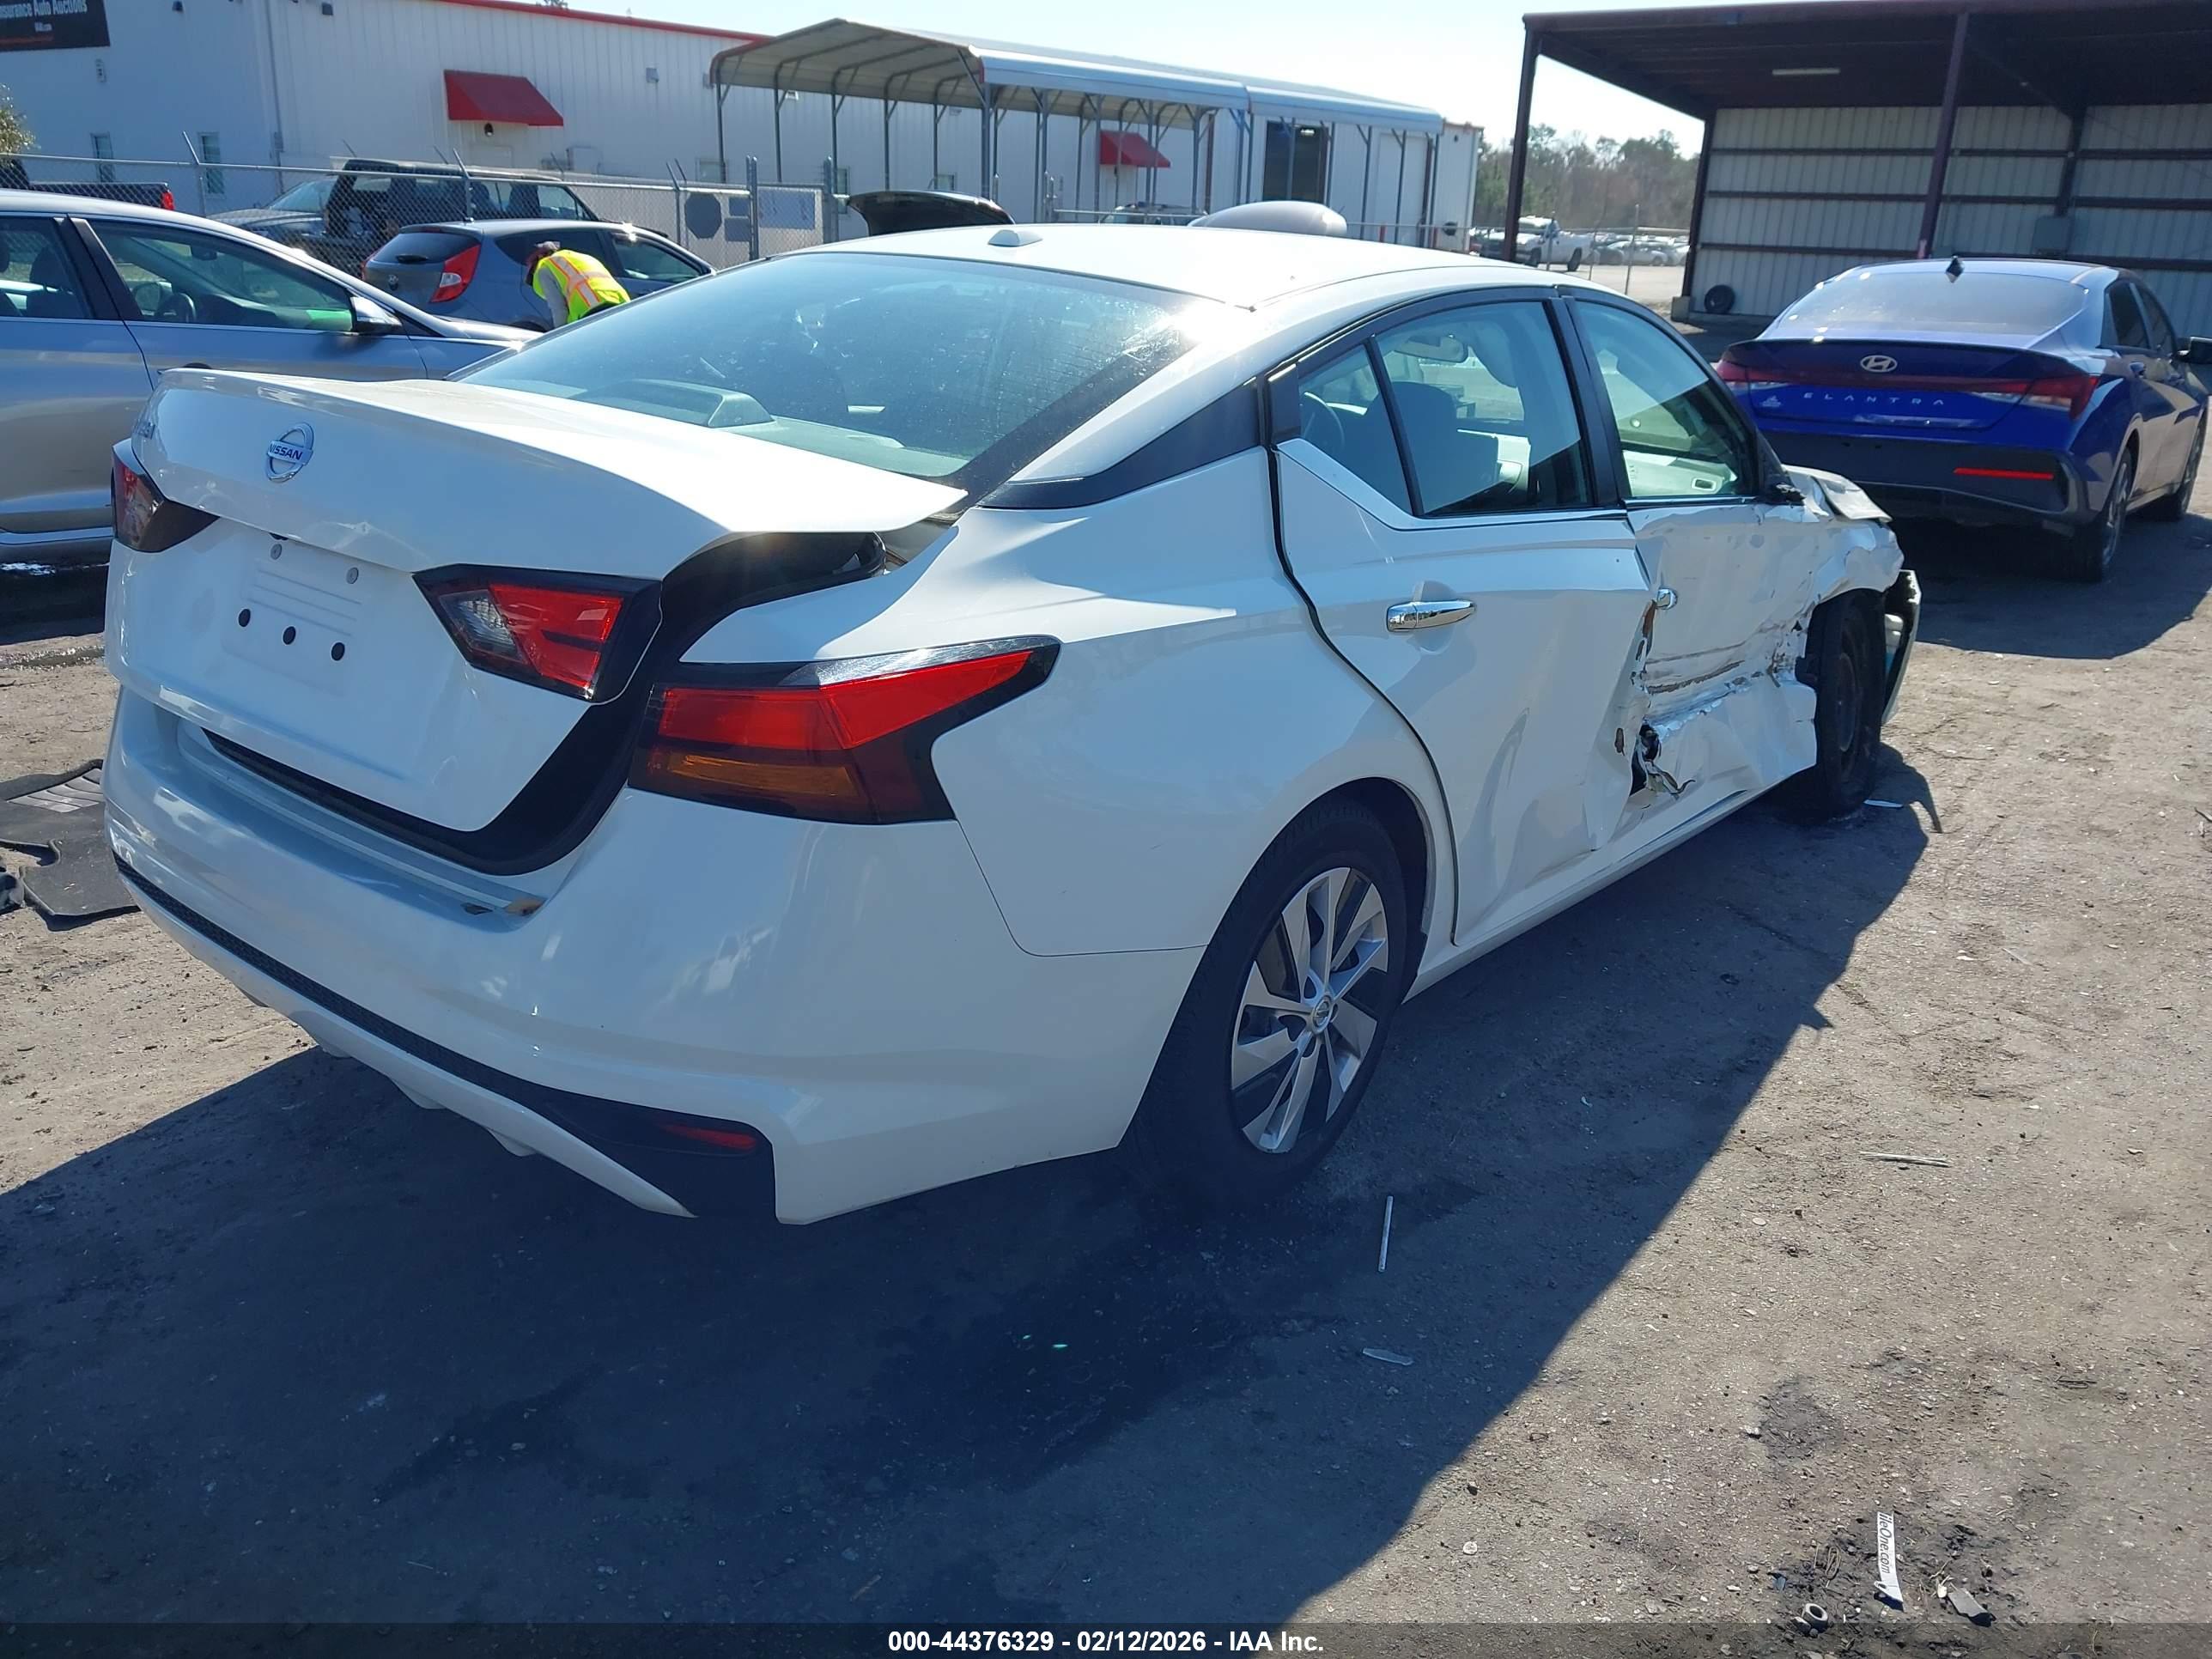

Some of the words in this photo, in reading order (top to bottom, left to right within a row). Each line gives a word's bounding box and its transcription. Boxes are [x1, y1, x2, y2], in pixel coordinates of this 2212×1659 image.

[33, 0, 52, 15] Auto
[52, 0, 88, 15] Auctions
[1803, 392, 1944, 405] ELANTRA
[270, 443, 303, 460] NISSAN
